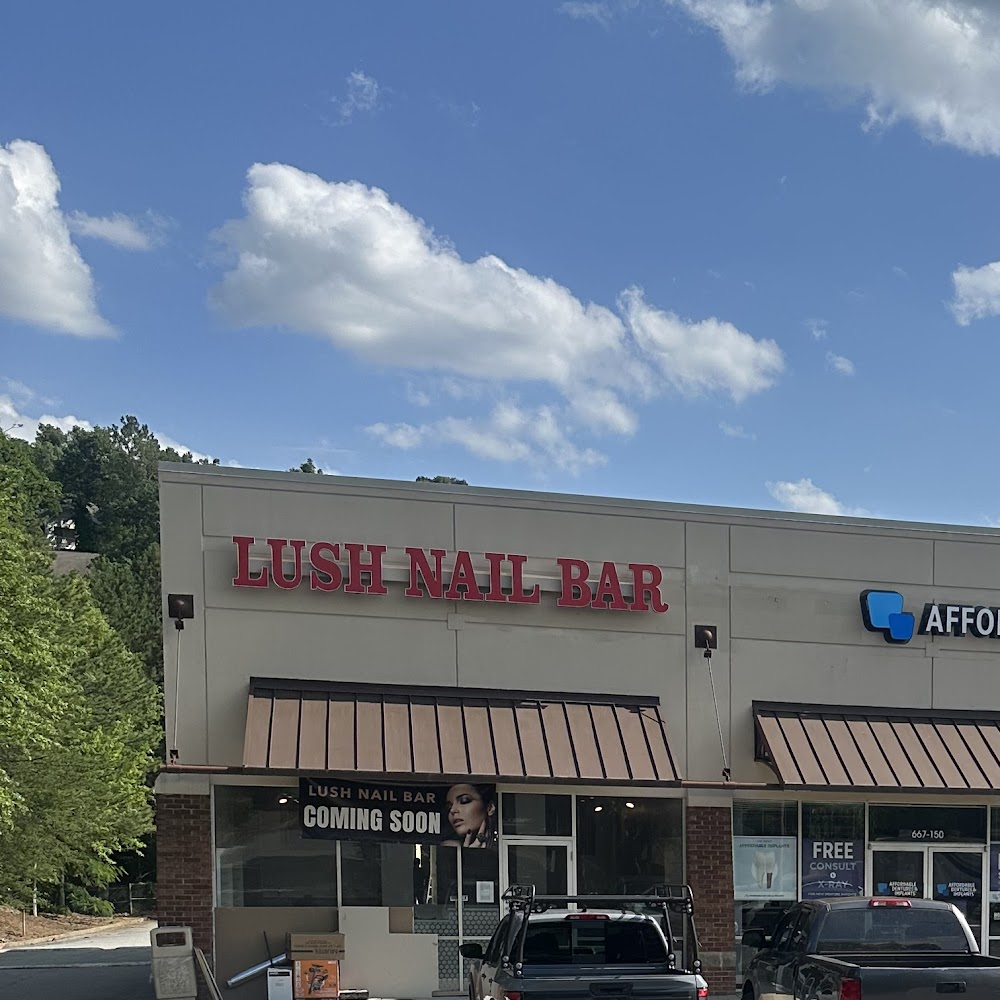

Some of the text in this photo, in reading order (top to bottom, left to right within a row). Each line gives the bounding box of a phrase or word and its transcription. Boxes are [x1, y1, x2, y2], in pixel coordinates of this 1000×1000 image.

[231, 535, 671, 614] LUSH NAIL BAR
[308, 784, 436, 804] LUSH NAIL BAR
[303, 804, 441, 834] COMING SOON
[911, 829, 945, 839] 667-150
[812, 841, 854, 859] FREE
[809, 862, 856, 871] CONSULT
[818, 880, 848, 889] X-RAY
